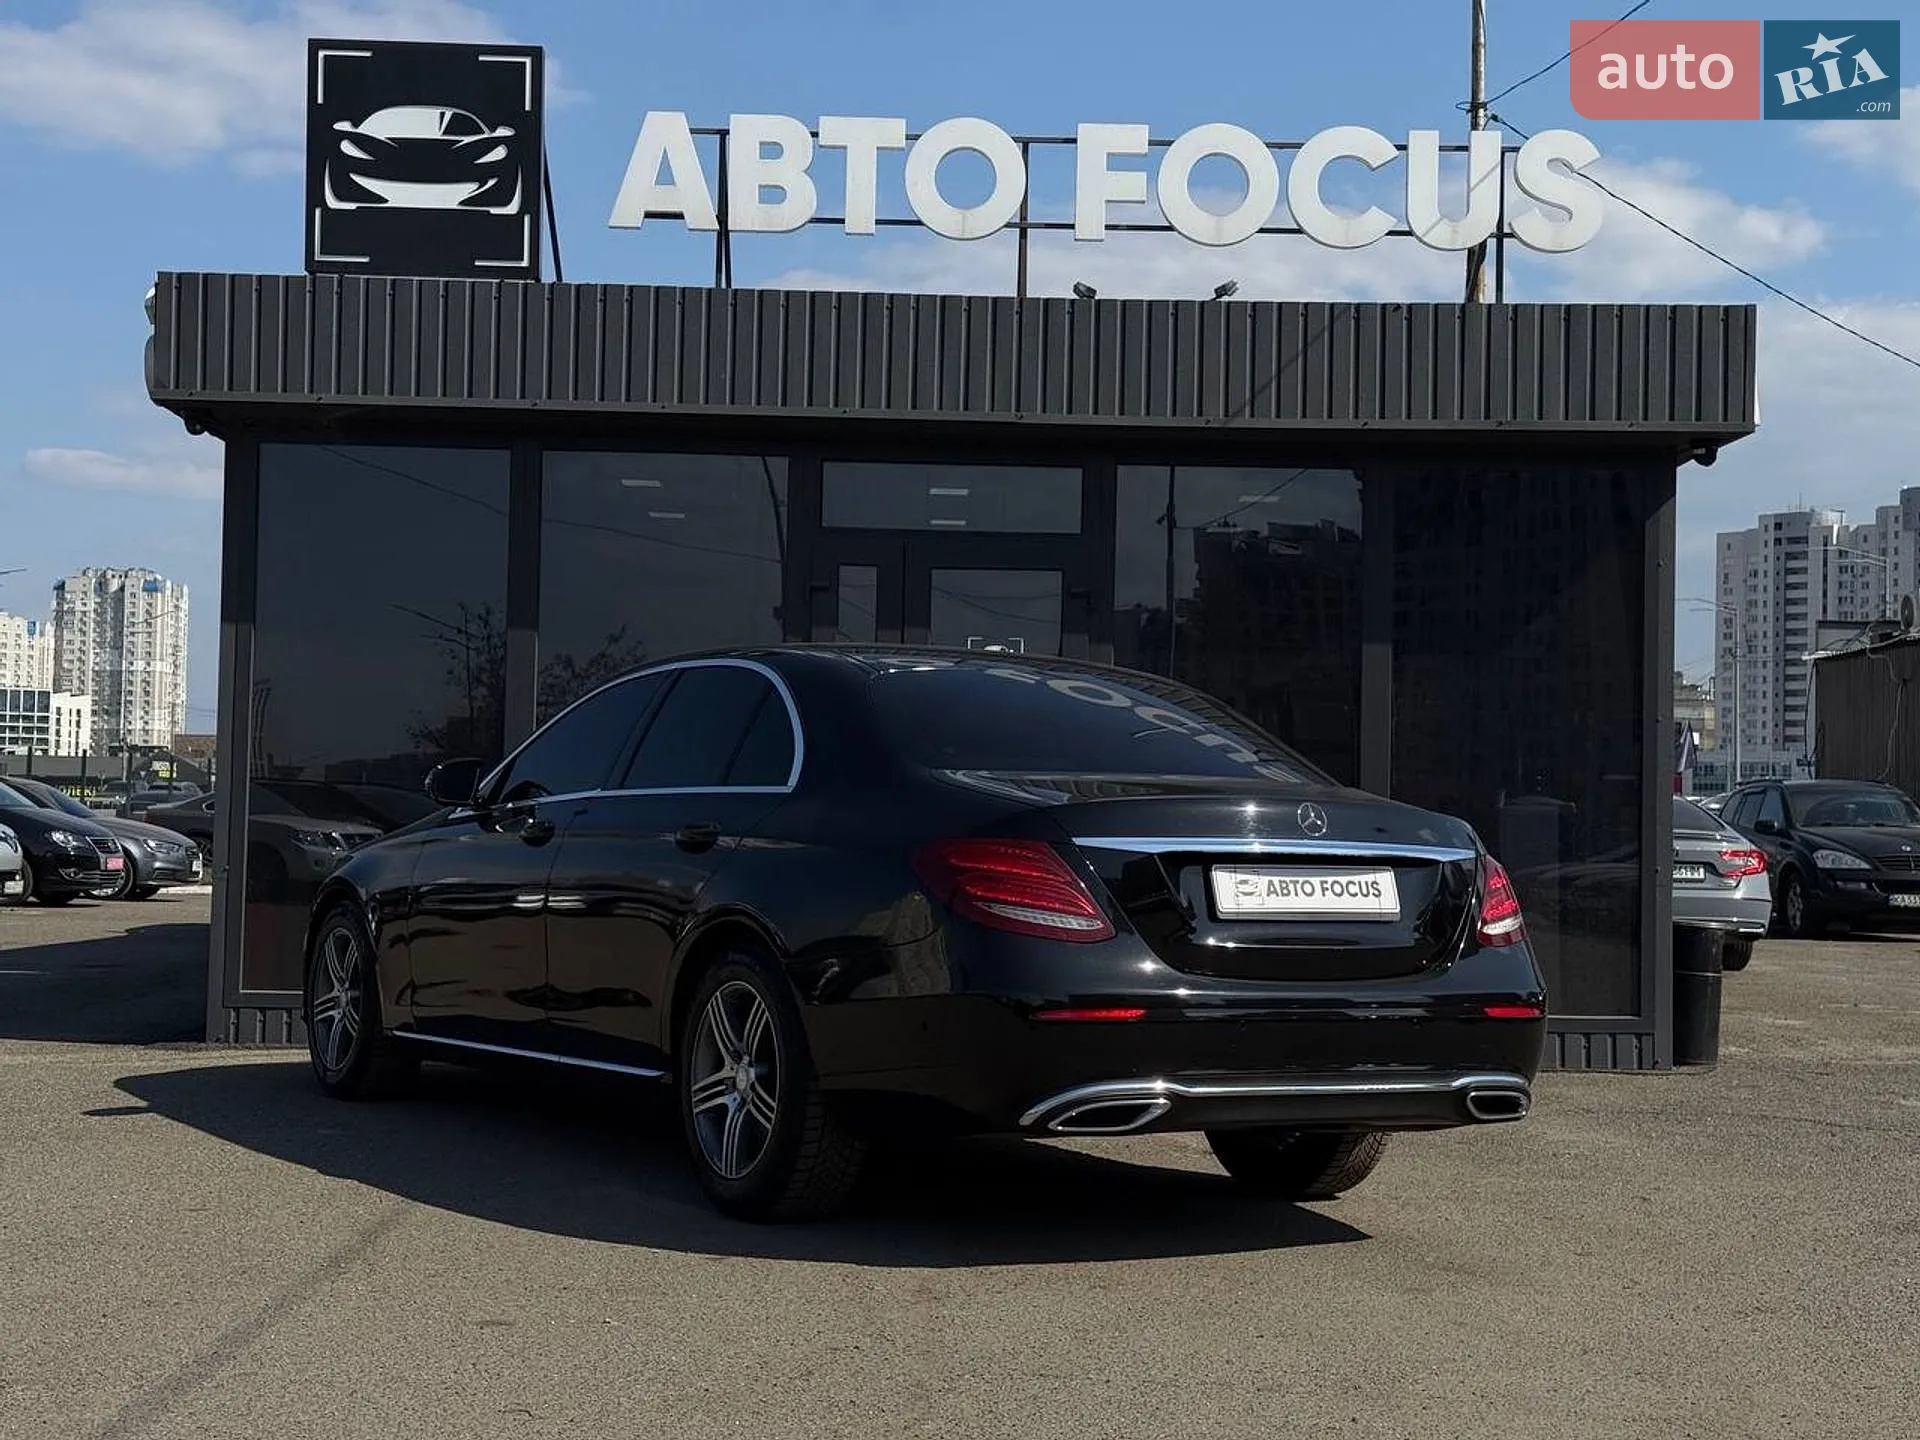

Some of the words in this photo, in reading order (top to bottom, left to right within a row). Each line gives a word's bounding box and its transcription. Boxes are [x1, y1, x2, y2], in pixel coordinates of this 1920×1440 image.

[608, 111, 1027, 241] АВТО
[1074, 122, 1604, 254] FOCUS
[1266, 879, 1316, 897] АВТО
[1320, 880, 1383, 898] FOCUS
